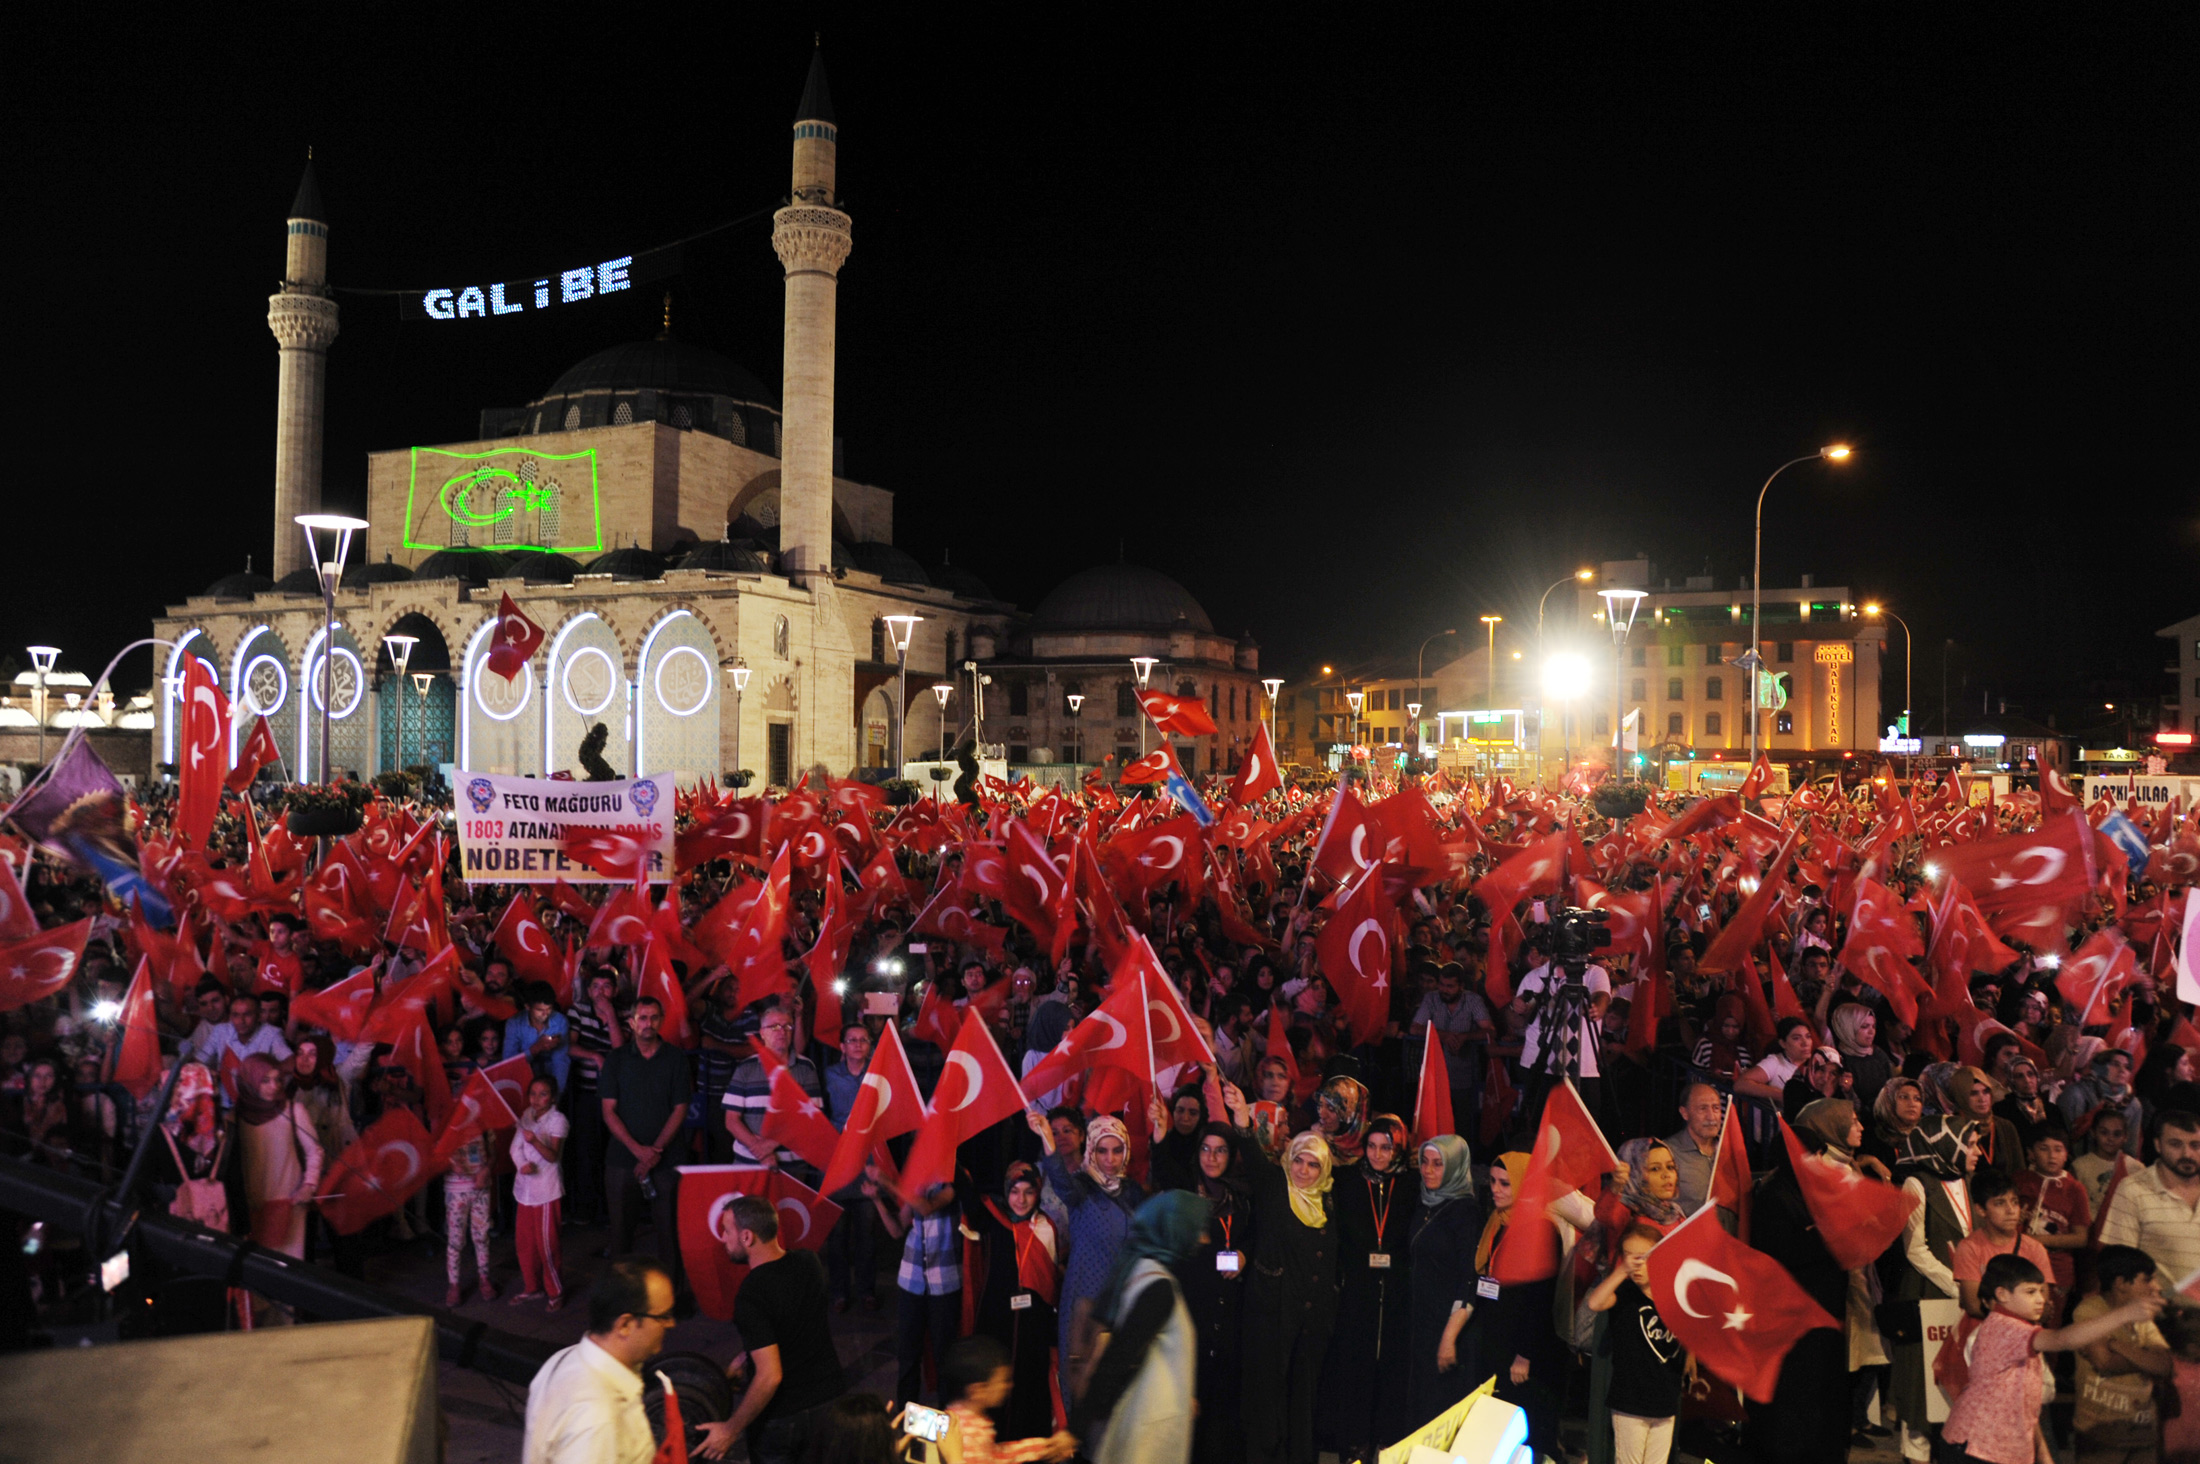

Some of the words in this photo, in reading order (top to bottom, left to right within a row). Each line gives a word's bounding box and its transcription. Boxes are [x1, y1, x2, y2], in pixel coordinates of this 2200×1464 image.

[1816, 651, 1852, 661] HOTEL
[2093, 784, 2169, 803] BOZKILILAR
[466, 819, 504, 839] 1803
[466, 841, 571, 872] NÖBETE
